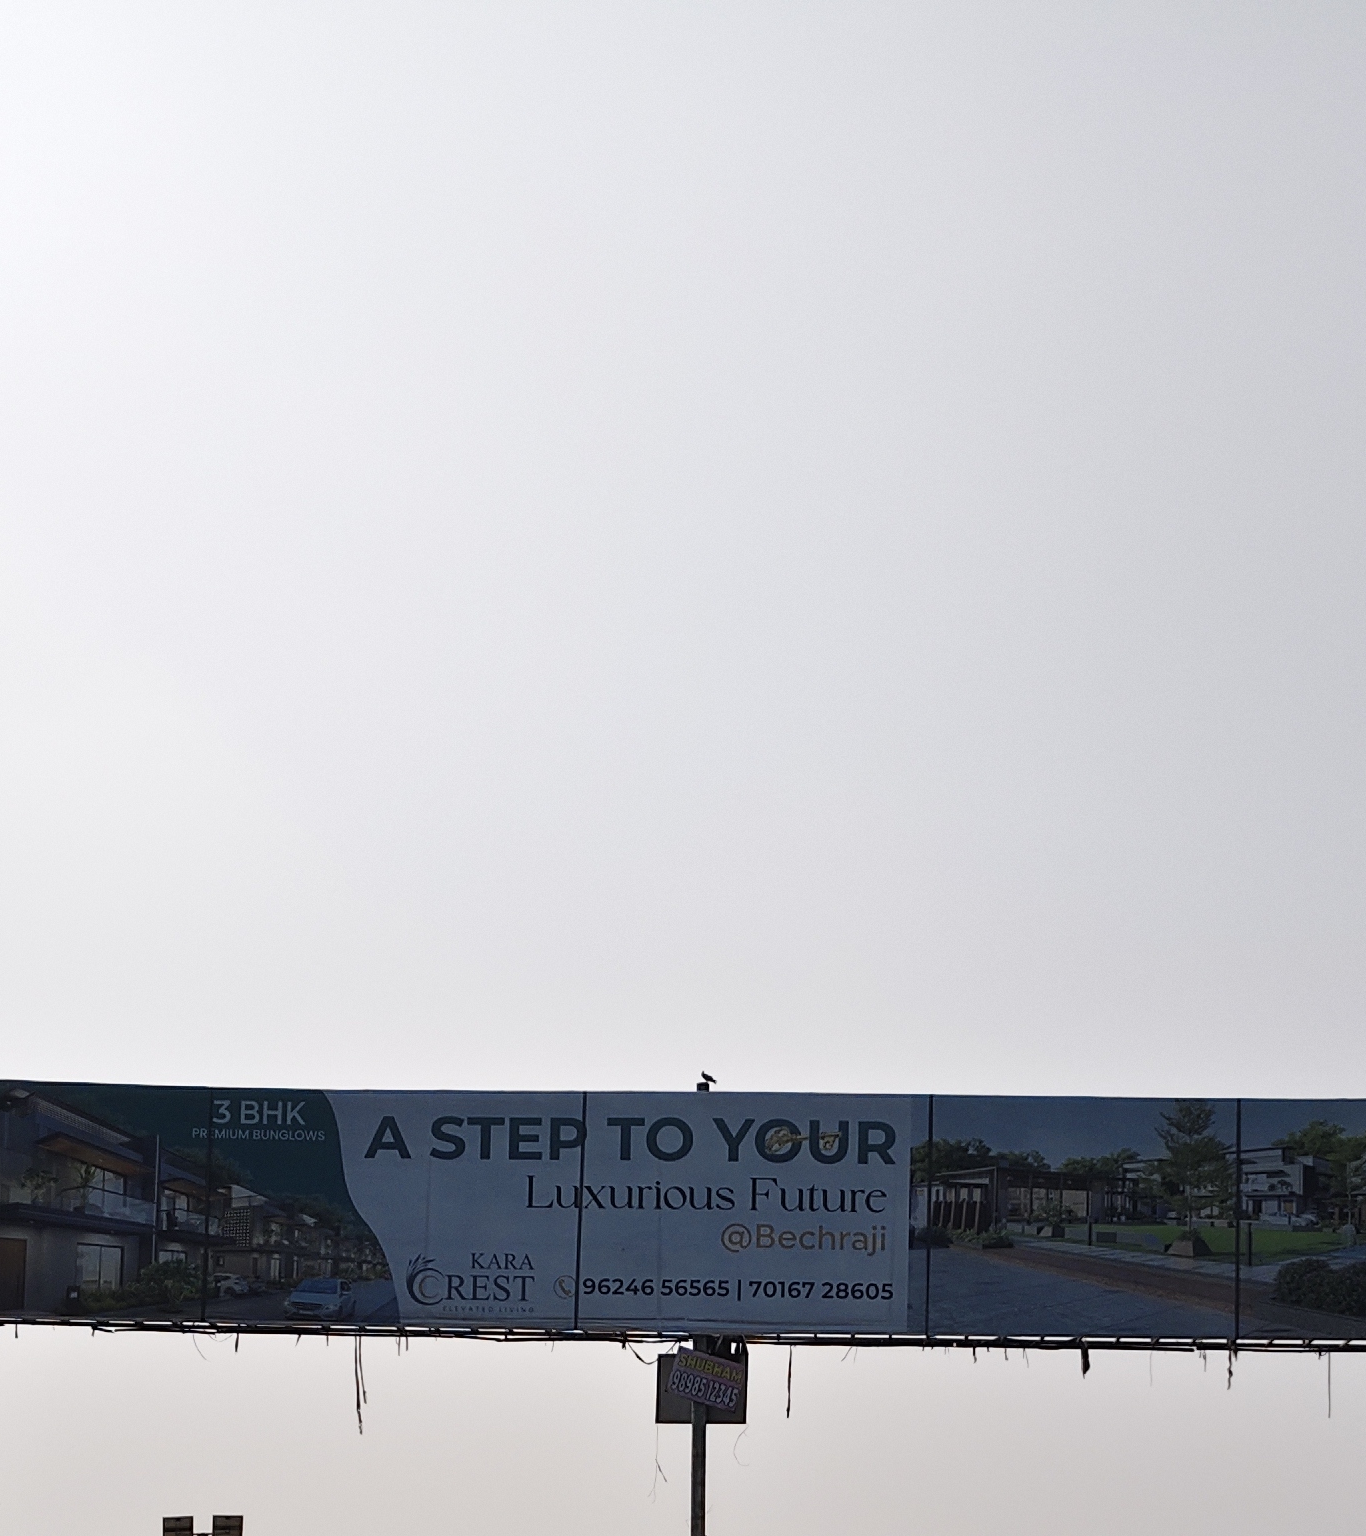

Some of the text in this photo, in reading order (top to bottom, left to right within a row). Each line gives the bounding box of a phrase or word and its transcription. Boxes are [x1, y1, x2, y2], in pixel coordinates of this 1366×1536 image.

[212, 1100, 306, 1125] 3 BHK
[252, 1129, 325, 1141] BUNGLOWS
[364, 1115, 896, 1165] A STEP TO YOUR
[526, 1174, 887, 1213] Luxurious Future
[721, 1223, 887, 1256] @Bechraji
[470, 1252, 535, 1271] KARA
[406, 1266, 535, 1306] CREST
[582, 1278, 654, 1297] 96246
[660, 1278, 730, 1298] 56565
[748, 1281, 815, 1299] 70167
[821, 1281, 894, 1301] 28605
[678, 1353, 744, 1384] SHUBHAM
